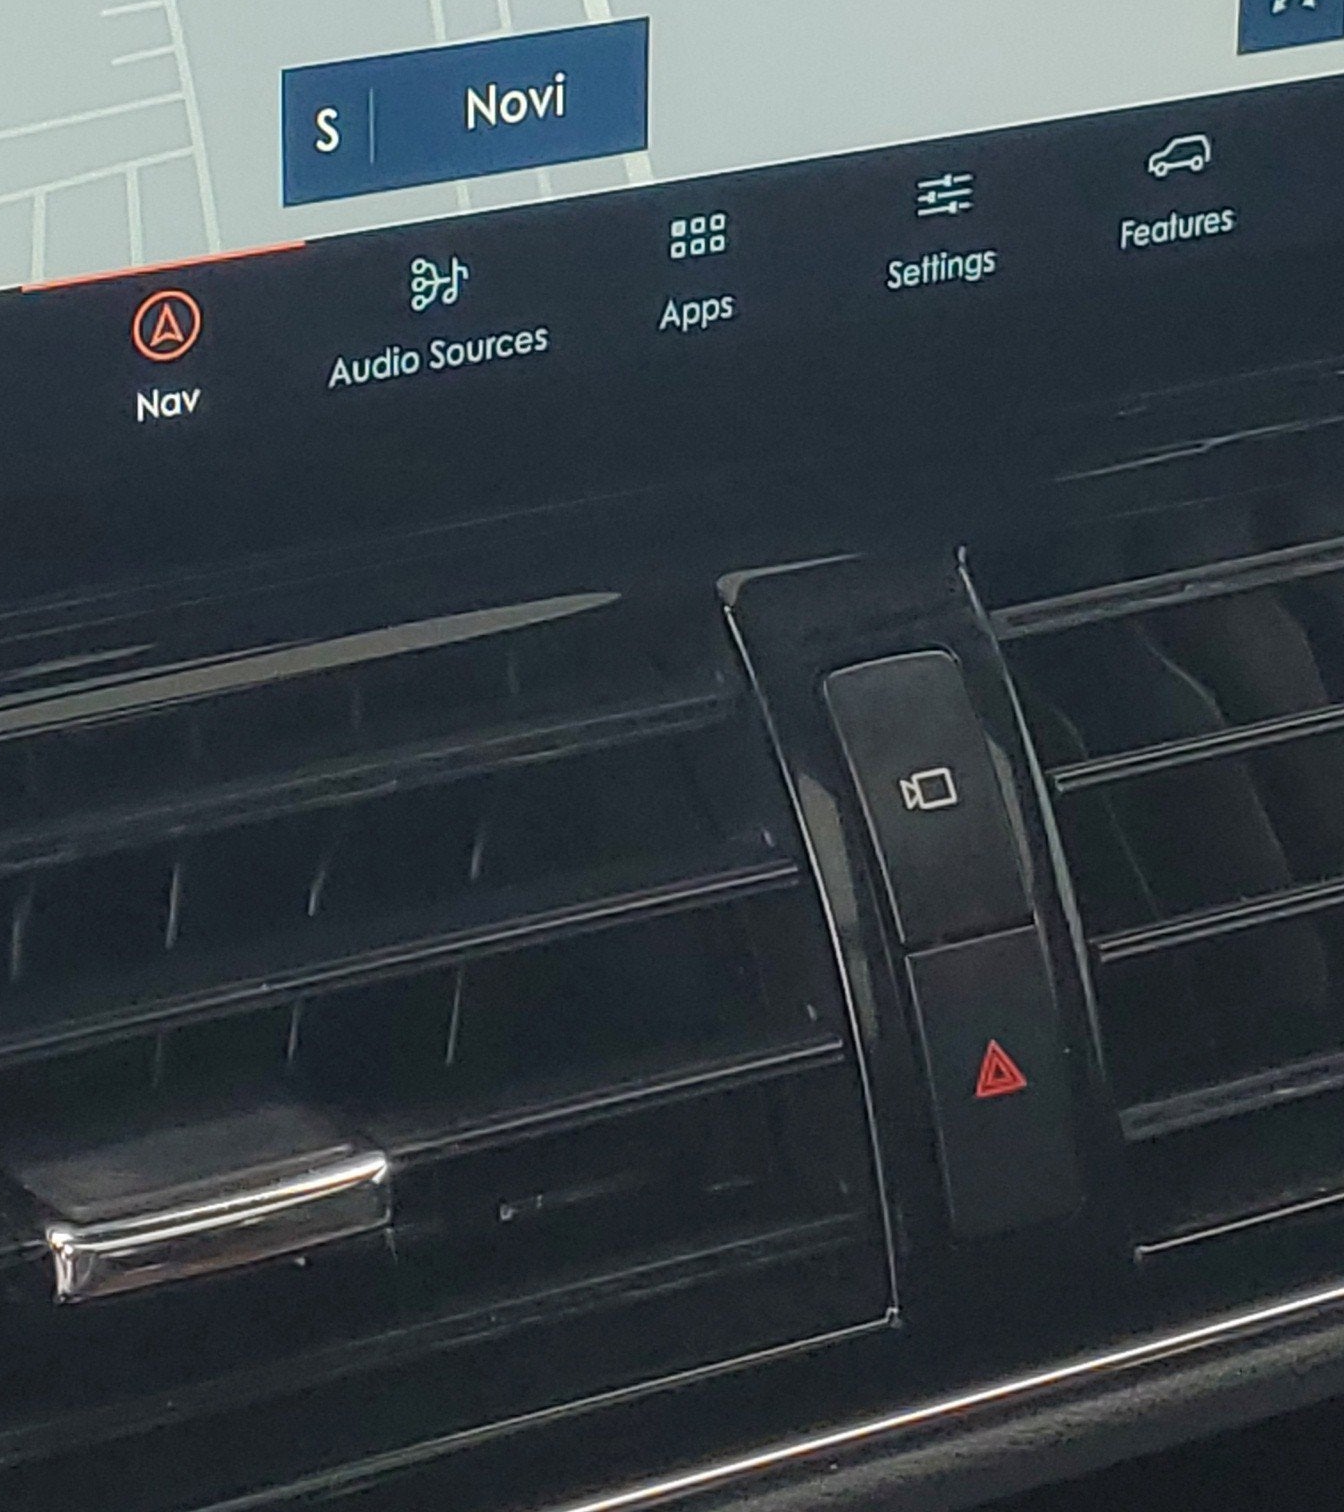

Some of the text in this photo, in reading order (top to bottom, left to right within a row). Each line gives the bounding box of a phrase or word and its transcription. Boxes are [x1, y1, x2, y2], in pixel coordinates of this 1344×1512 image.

[465, 74, 567, 132] Novi
[315, 108, 339, 152] S
[1121, 207, 1236, 249] Features
[887, 246, 996, 291] Settings
[660, 291, 734, 331] Apps
[328, 323, 548, 389] Audio Sources
[137, 386, 201, 422] Nav
